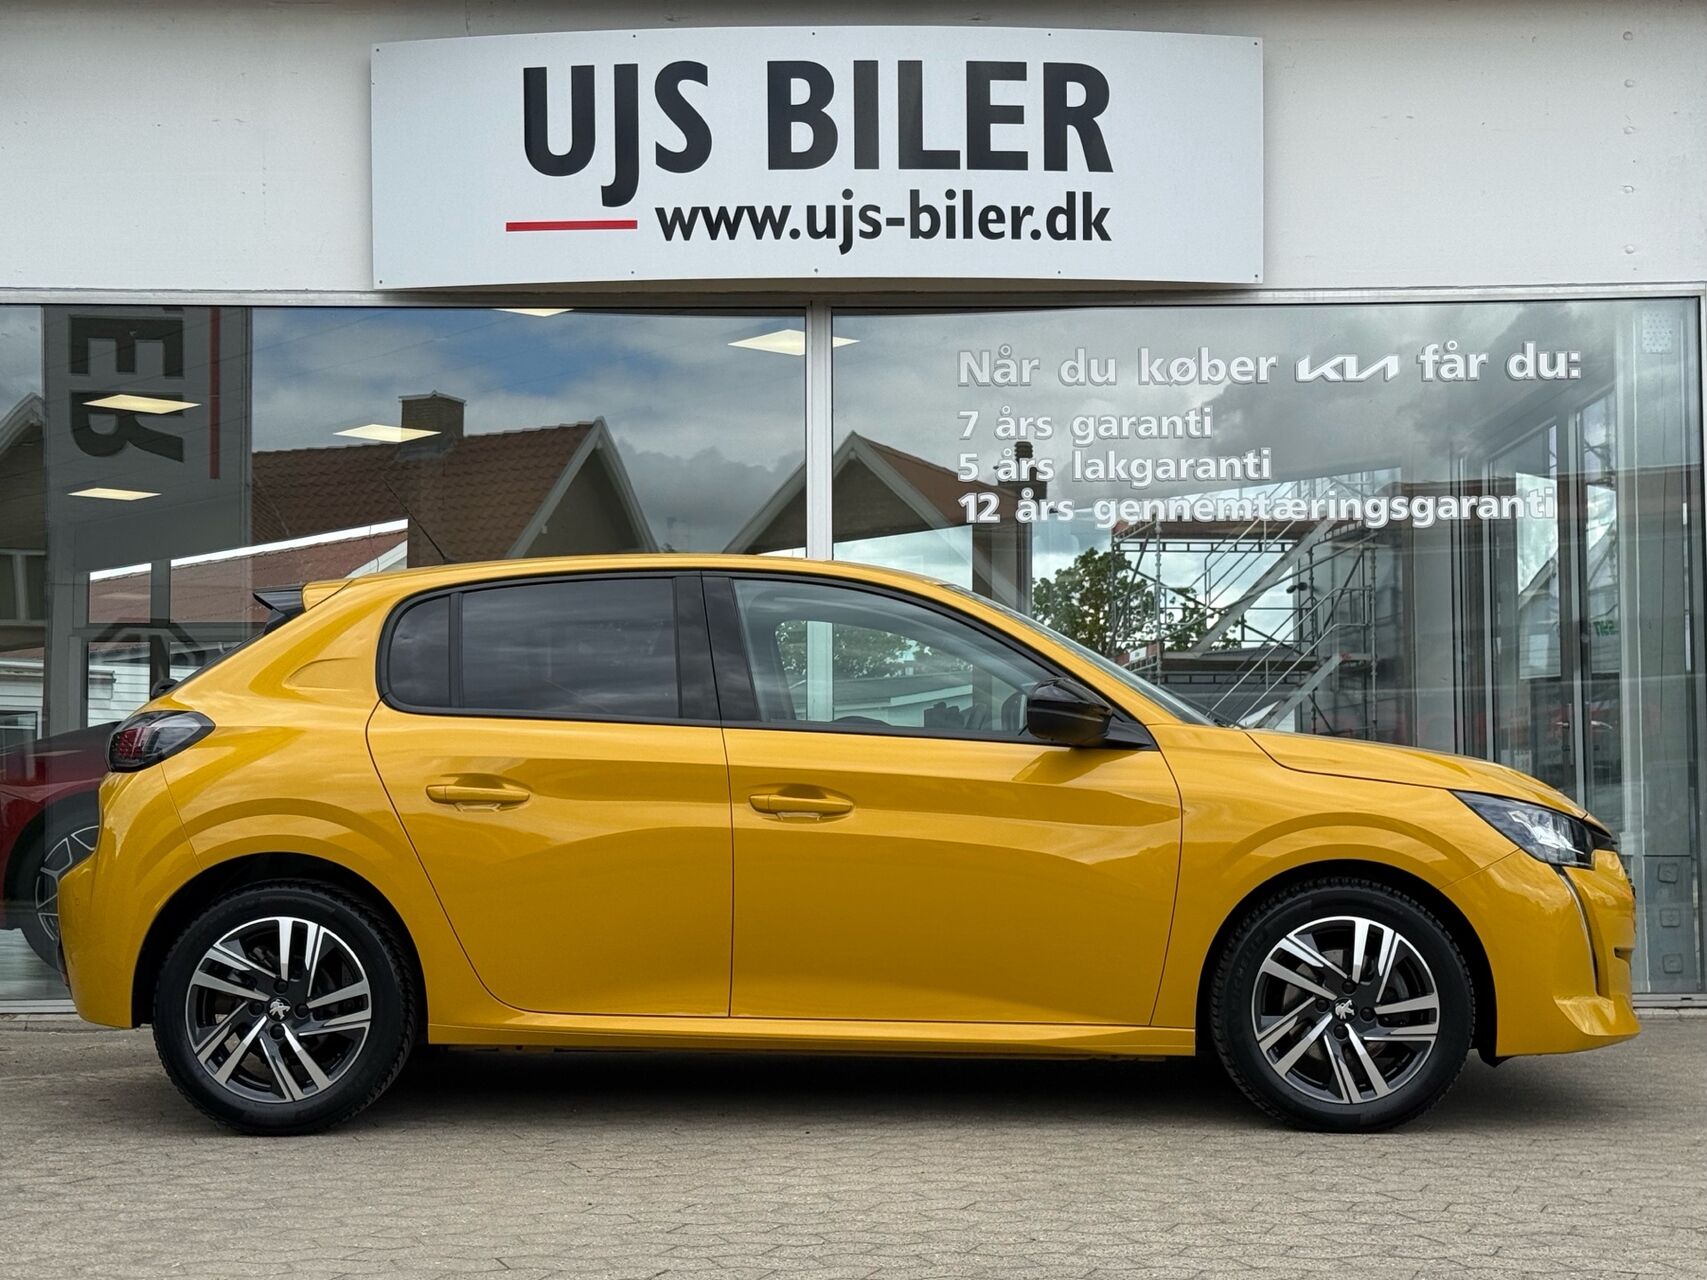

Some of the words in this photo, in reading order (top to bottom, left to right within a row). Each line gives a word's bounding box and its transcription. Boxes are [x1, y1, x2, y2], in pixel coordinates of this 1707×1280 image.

[523, 61, 713, 206] UJS
[766, 61, 1113, 172] BILER
[655, 189, 1112, 254] www.ujs-biler.dk
[958, 344, 1040, 386] Når
[1059, 347, 1117, 386] du
[1138, 347, 1278, 386] køber
[1417, 340, 1489, 381] får
[1506, 341, 1582, 380] du:
[958, 410, 979, 440] 7
[994, 405, 1053, 440] års
[1070, 405, 1214, 448] garanti
[958, 453, 979, 482] 5
[996, 447, 1055, 482] års
[1072, 447, 1272, 489] lakgaranti
[958, 492, 1000, 523] 12
[1015, 488, 1075, 522] års
[1093, 487, 1556, 528] gennemtæringsgaranti
